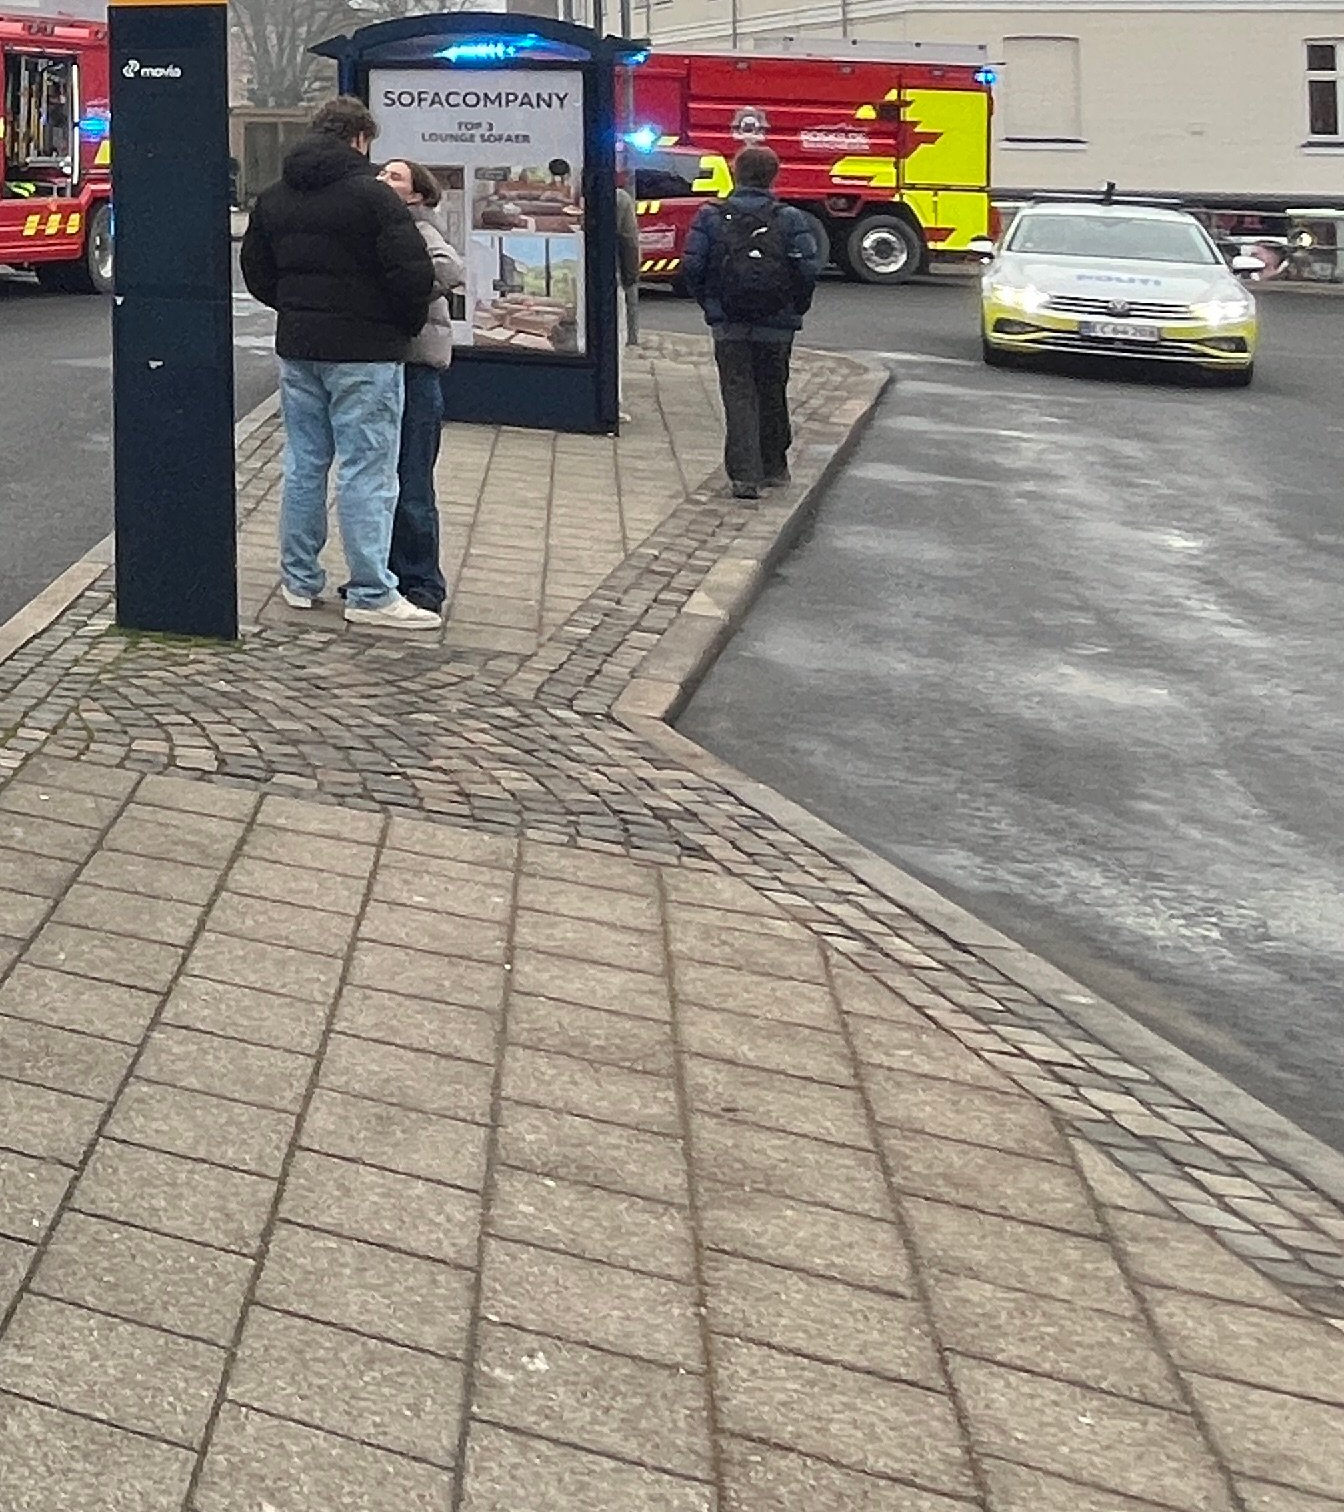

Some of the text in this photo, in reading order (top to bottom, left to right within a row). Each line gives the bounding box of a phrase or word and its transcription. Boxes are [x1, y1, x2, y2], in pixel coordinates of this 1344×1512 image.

[382, 90, 570, 109] SOFACOMPANY
[457, 121, 482, 131] TOP
[421, 132, 476, 143] LOUNGE
